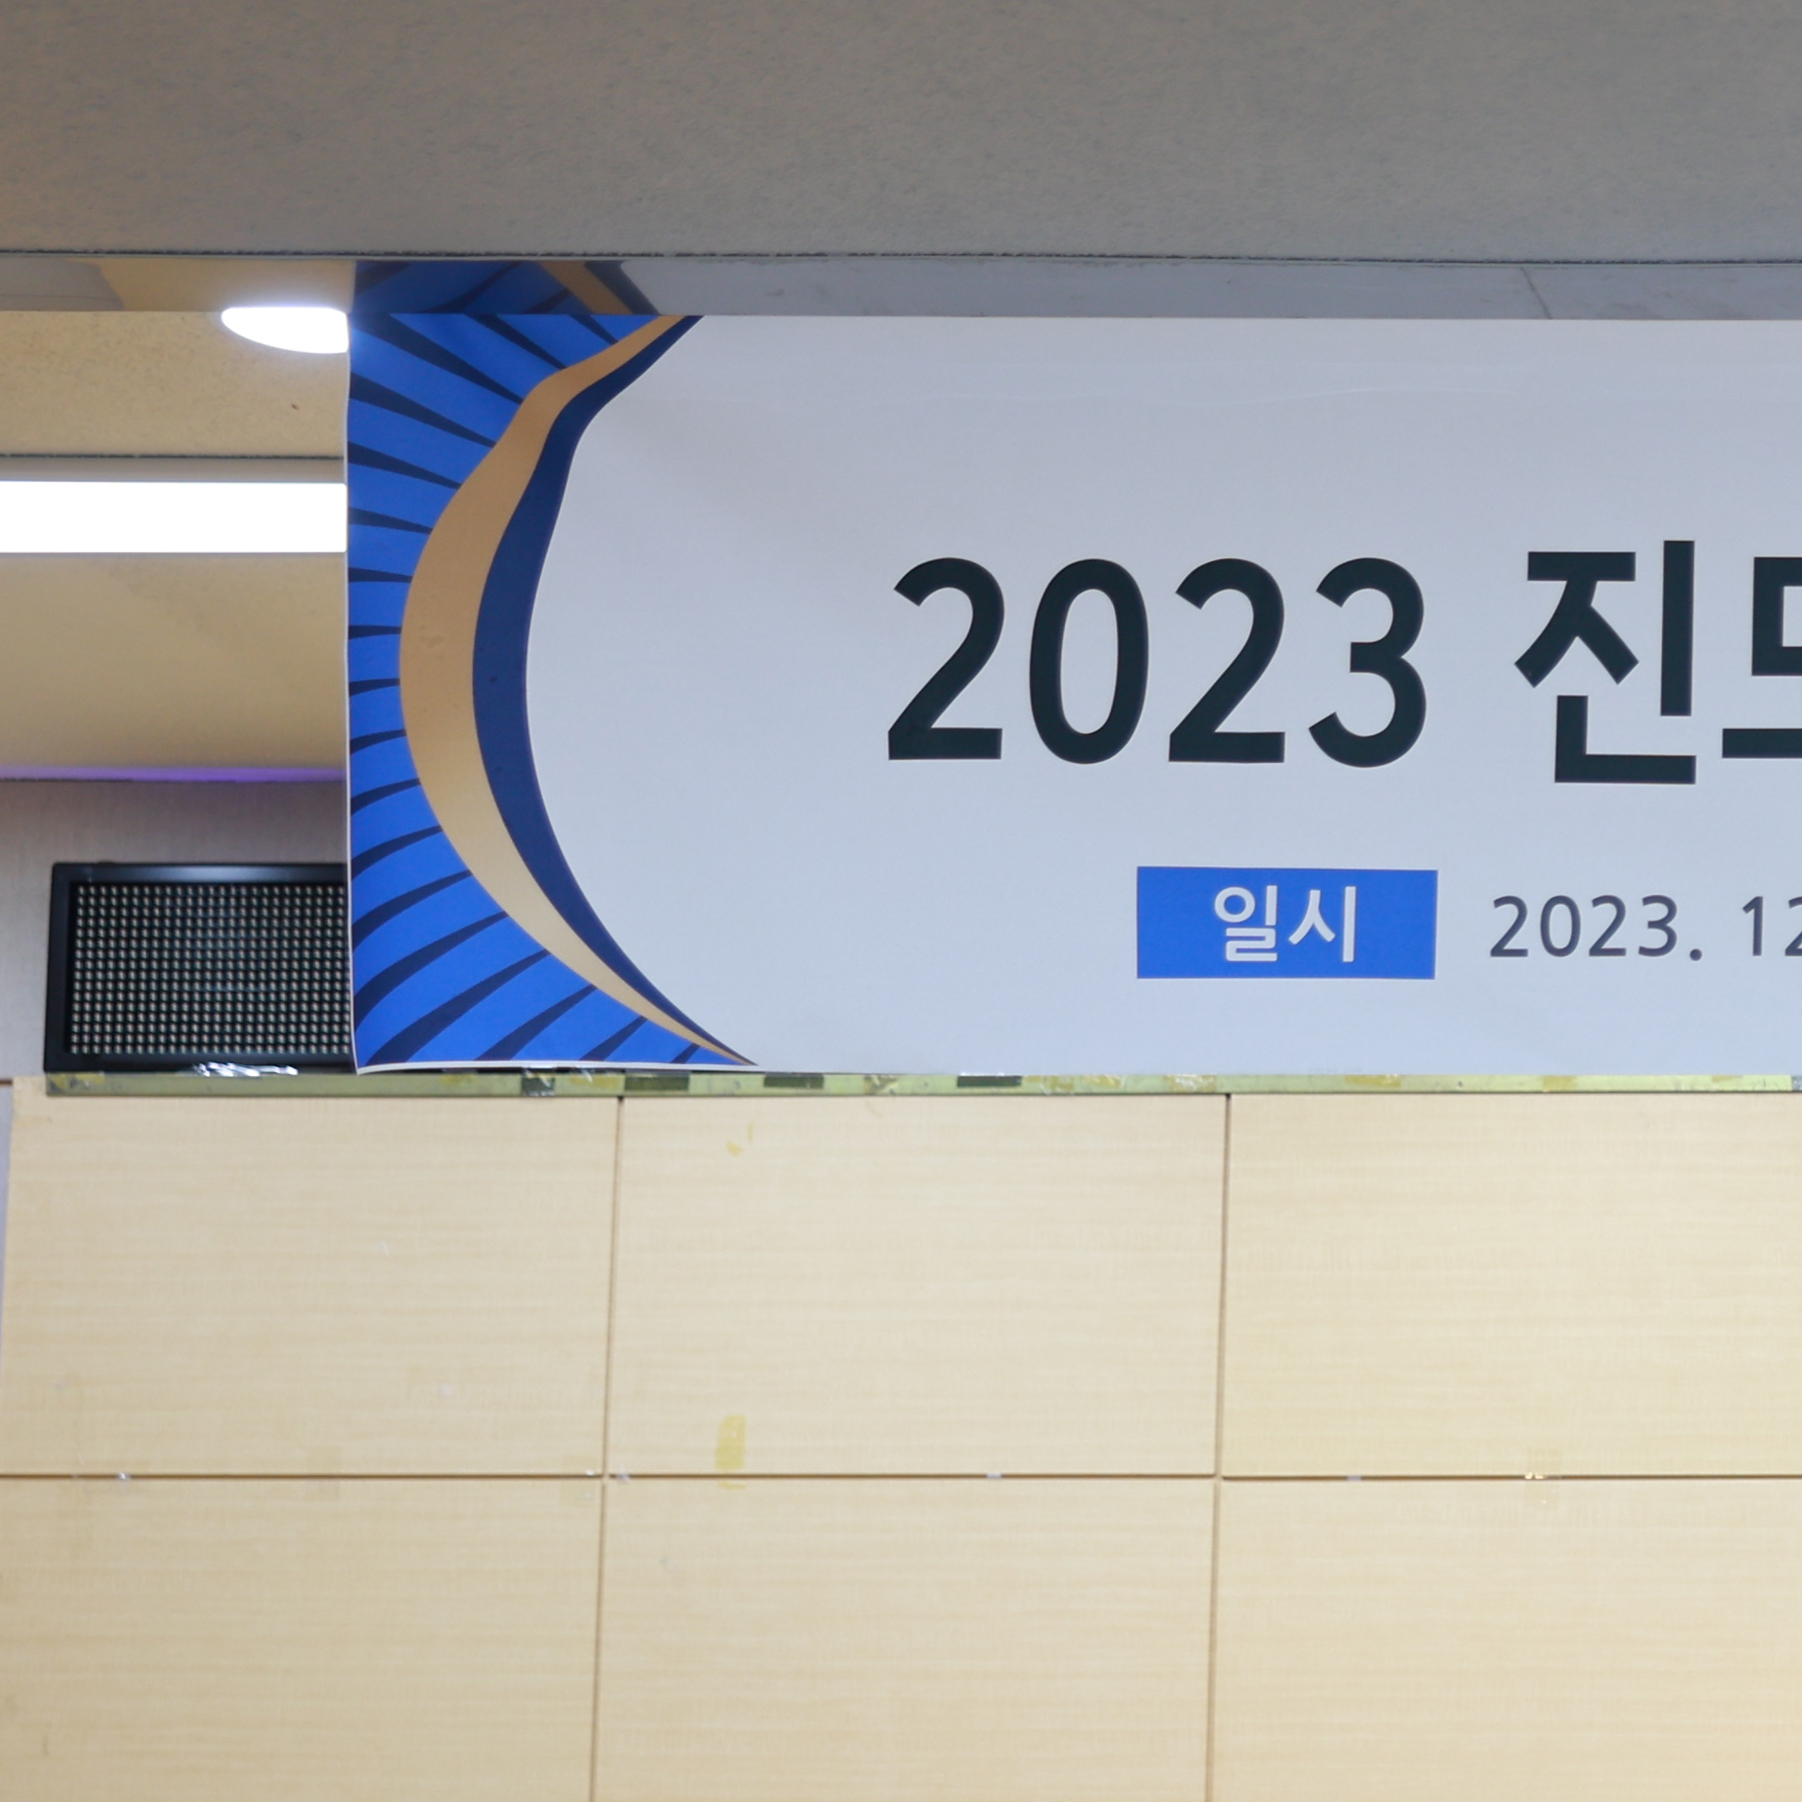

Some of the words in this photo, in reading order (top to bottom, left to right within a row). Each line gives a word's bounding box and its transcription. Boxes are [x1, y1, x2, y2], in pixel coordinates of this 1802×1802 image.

[888, 558, 1426, 767] 2023
[1214, 885, 1356, 962] 일시
[1491, 895, 1701, 960] 2023.
